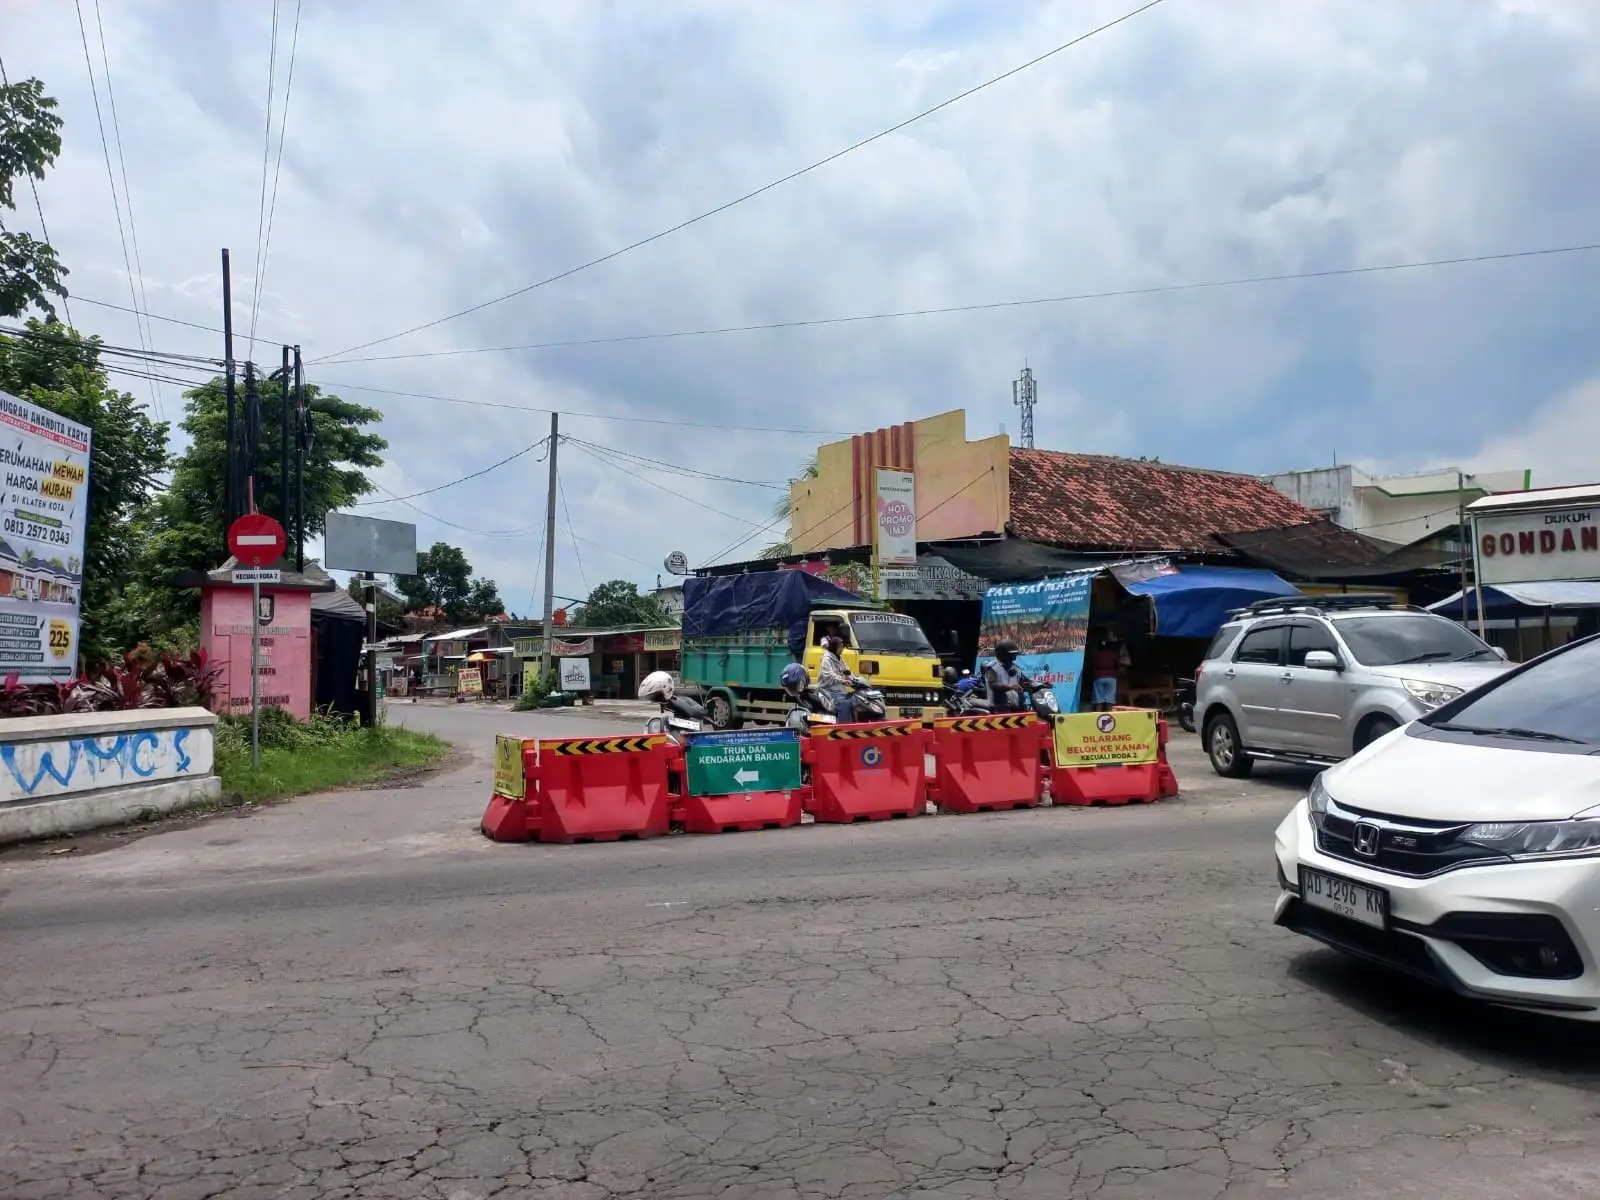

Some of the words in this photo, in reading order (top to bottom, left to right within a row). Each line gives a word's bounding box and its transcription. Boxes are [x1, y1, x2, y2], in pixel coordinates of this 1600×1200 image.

[53, 463, 84, 481] MEWAH
[6, 472, 39, 492] HARGA
[41, 481, 73, 499] MURAH
[12, 494, 20, 503] DI
[22, 497, 47, 508] KLATEN
[48, 501, 65, 512] KOTA
[887, 504, 906, 515] HOT
[880, 513, 914, 526] PROMO
[1544, 512, 1591, 525] DUKUH
[4, 518, 24, 534] 0813
[26, 524, 48, 540] 2572
[889, 524, 905, 536] IM3
[49, 630, 69, 648] 225
[1082, 734, 1132, 743] DILARANG
[723, 746, 747, 755] TRUK
[748, 745, 767, 754] DAN
[1066, 745, 1099, 754] BELOK
[1100, 744, 1114, 752] KE
[1115, 743, 1150, 751] KANAN
[698, 754, 753, 765] KENDARAAN
[754, 752, 790, 762] BARANG
[1080, 753, 1111, 761] KECUALI
[1307, 873, 1321, 894] AD
[1326, 879, 1357, 906] 1296
